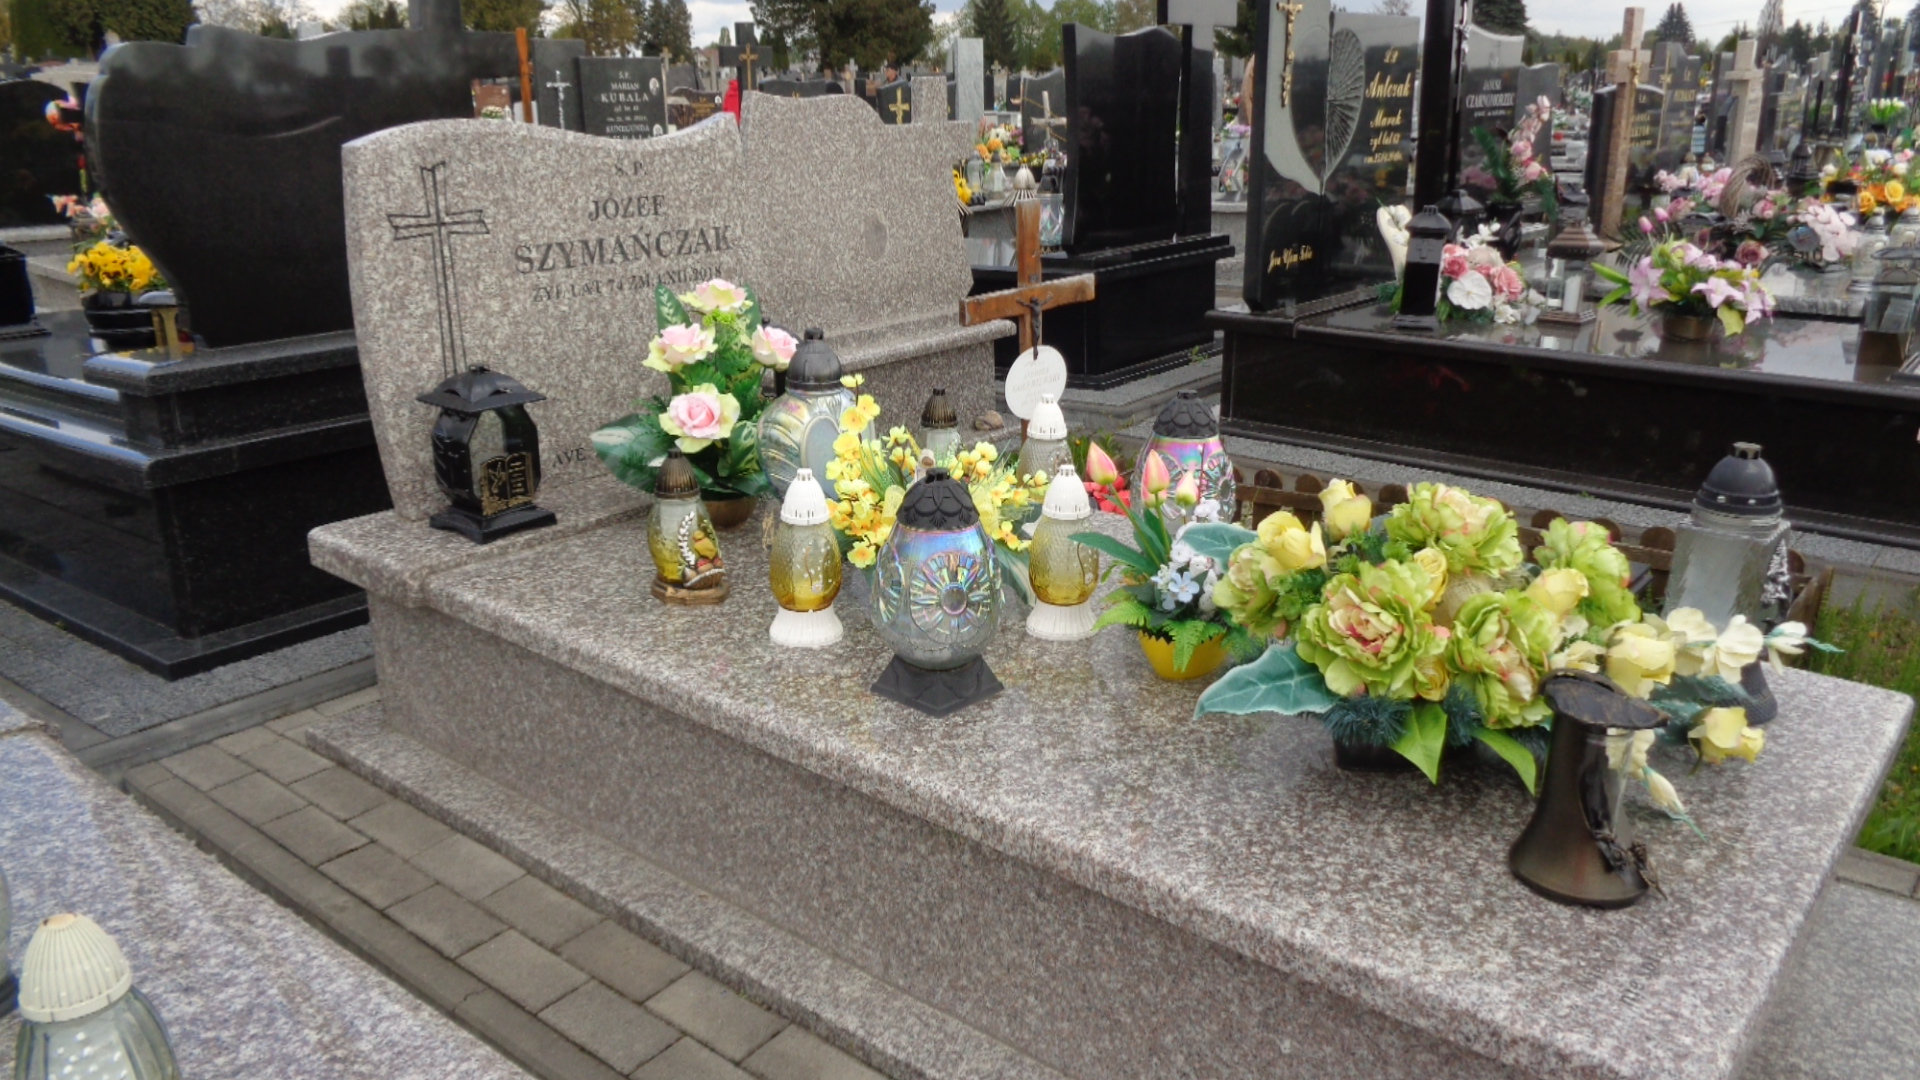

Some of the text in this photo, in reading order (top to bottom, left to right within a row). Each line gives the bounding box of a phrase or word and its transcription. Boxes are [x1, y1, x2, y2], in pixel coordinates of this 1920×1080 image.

[610, 82, 640, 91] MARIAN
[601, 92, 649, 103] KUBALA
[588, 191, 665, 222] JÓZEF
[514, 225, 733, 274] SZYMAŃCZAK
[552, 447, 586, 468] AVE
